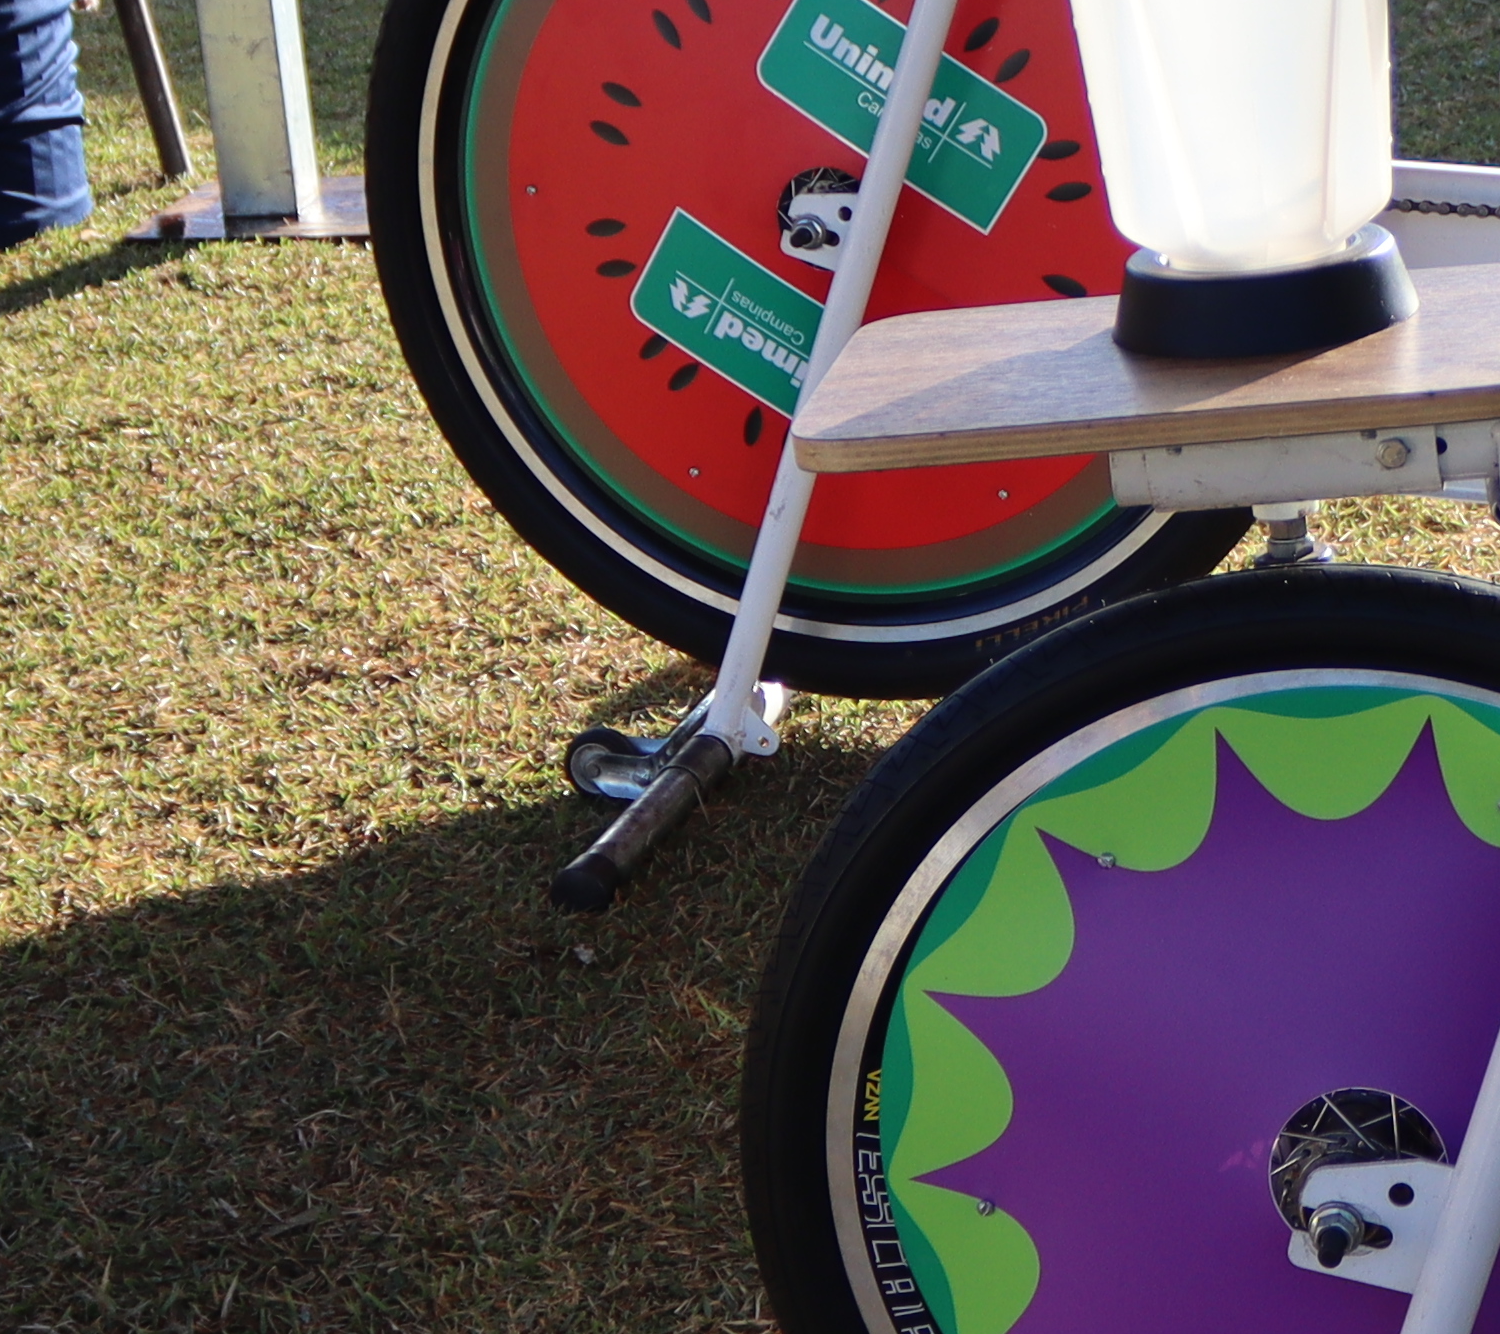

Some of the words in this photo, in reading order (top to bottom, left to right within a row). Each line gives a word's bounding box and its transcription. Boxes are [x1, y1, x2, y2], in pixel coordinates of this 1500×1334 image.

[810, 14, 956, 128] Unimd
[713, 310, 810, 389] imed
[731, 290, 805, 346] Campinas
[975, 595, 1090, 651] PIRELLI
